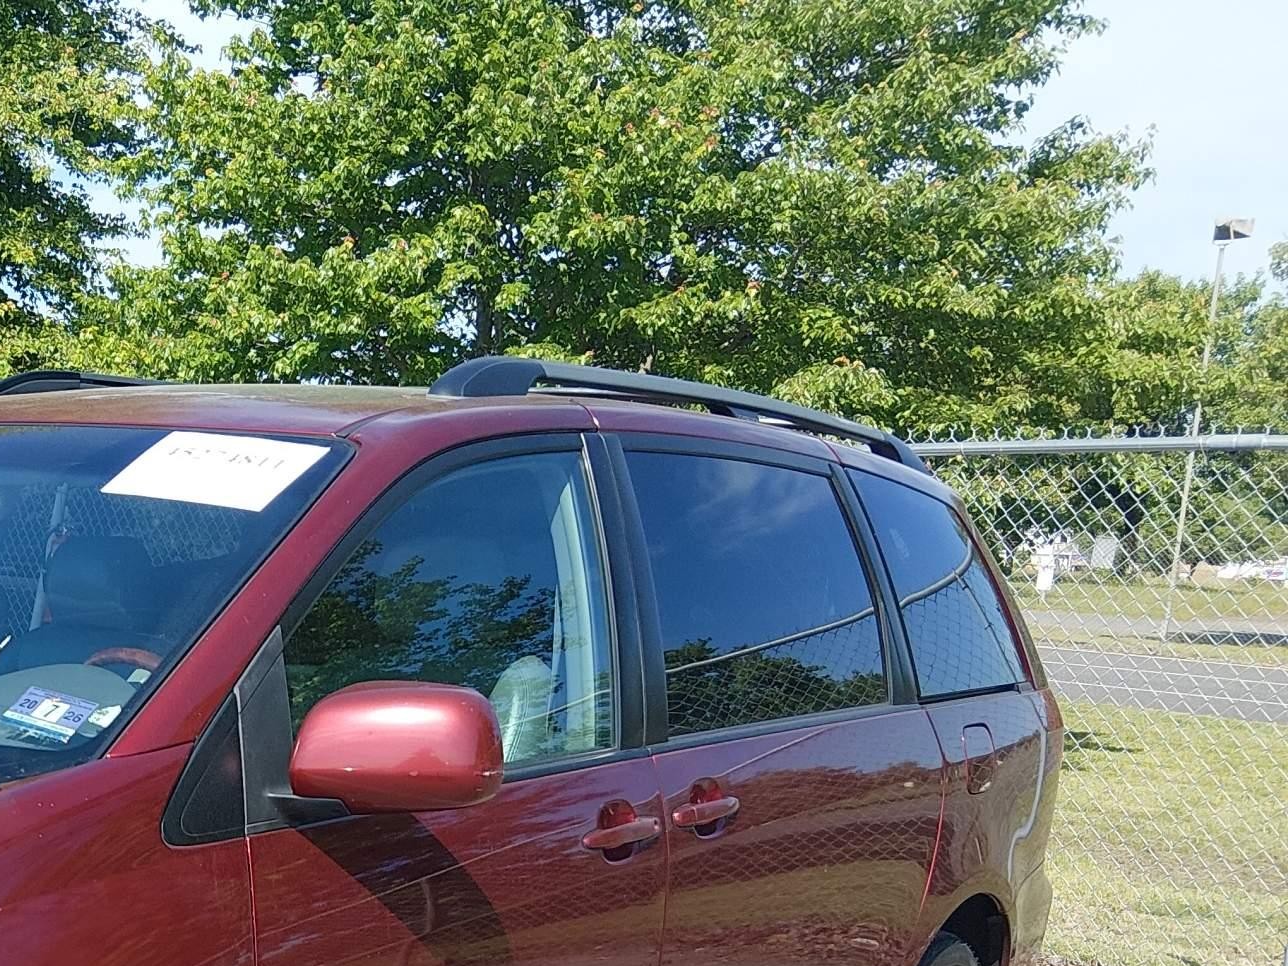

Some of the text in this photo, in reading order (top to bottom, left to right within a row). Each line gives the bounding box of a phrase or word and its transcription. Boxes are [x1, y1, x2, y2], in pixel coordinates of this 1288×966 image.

[19, 698, 39, 710] 20
[43, 703, 60, 718] 7
[64, 711, 84, 723] 26
